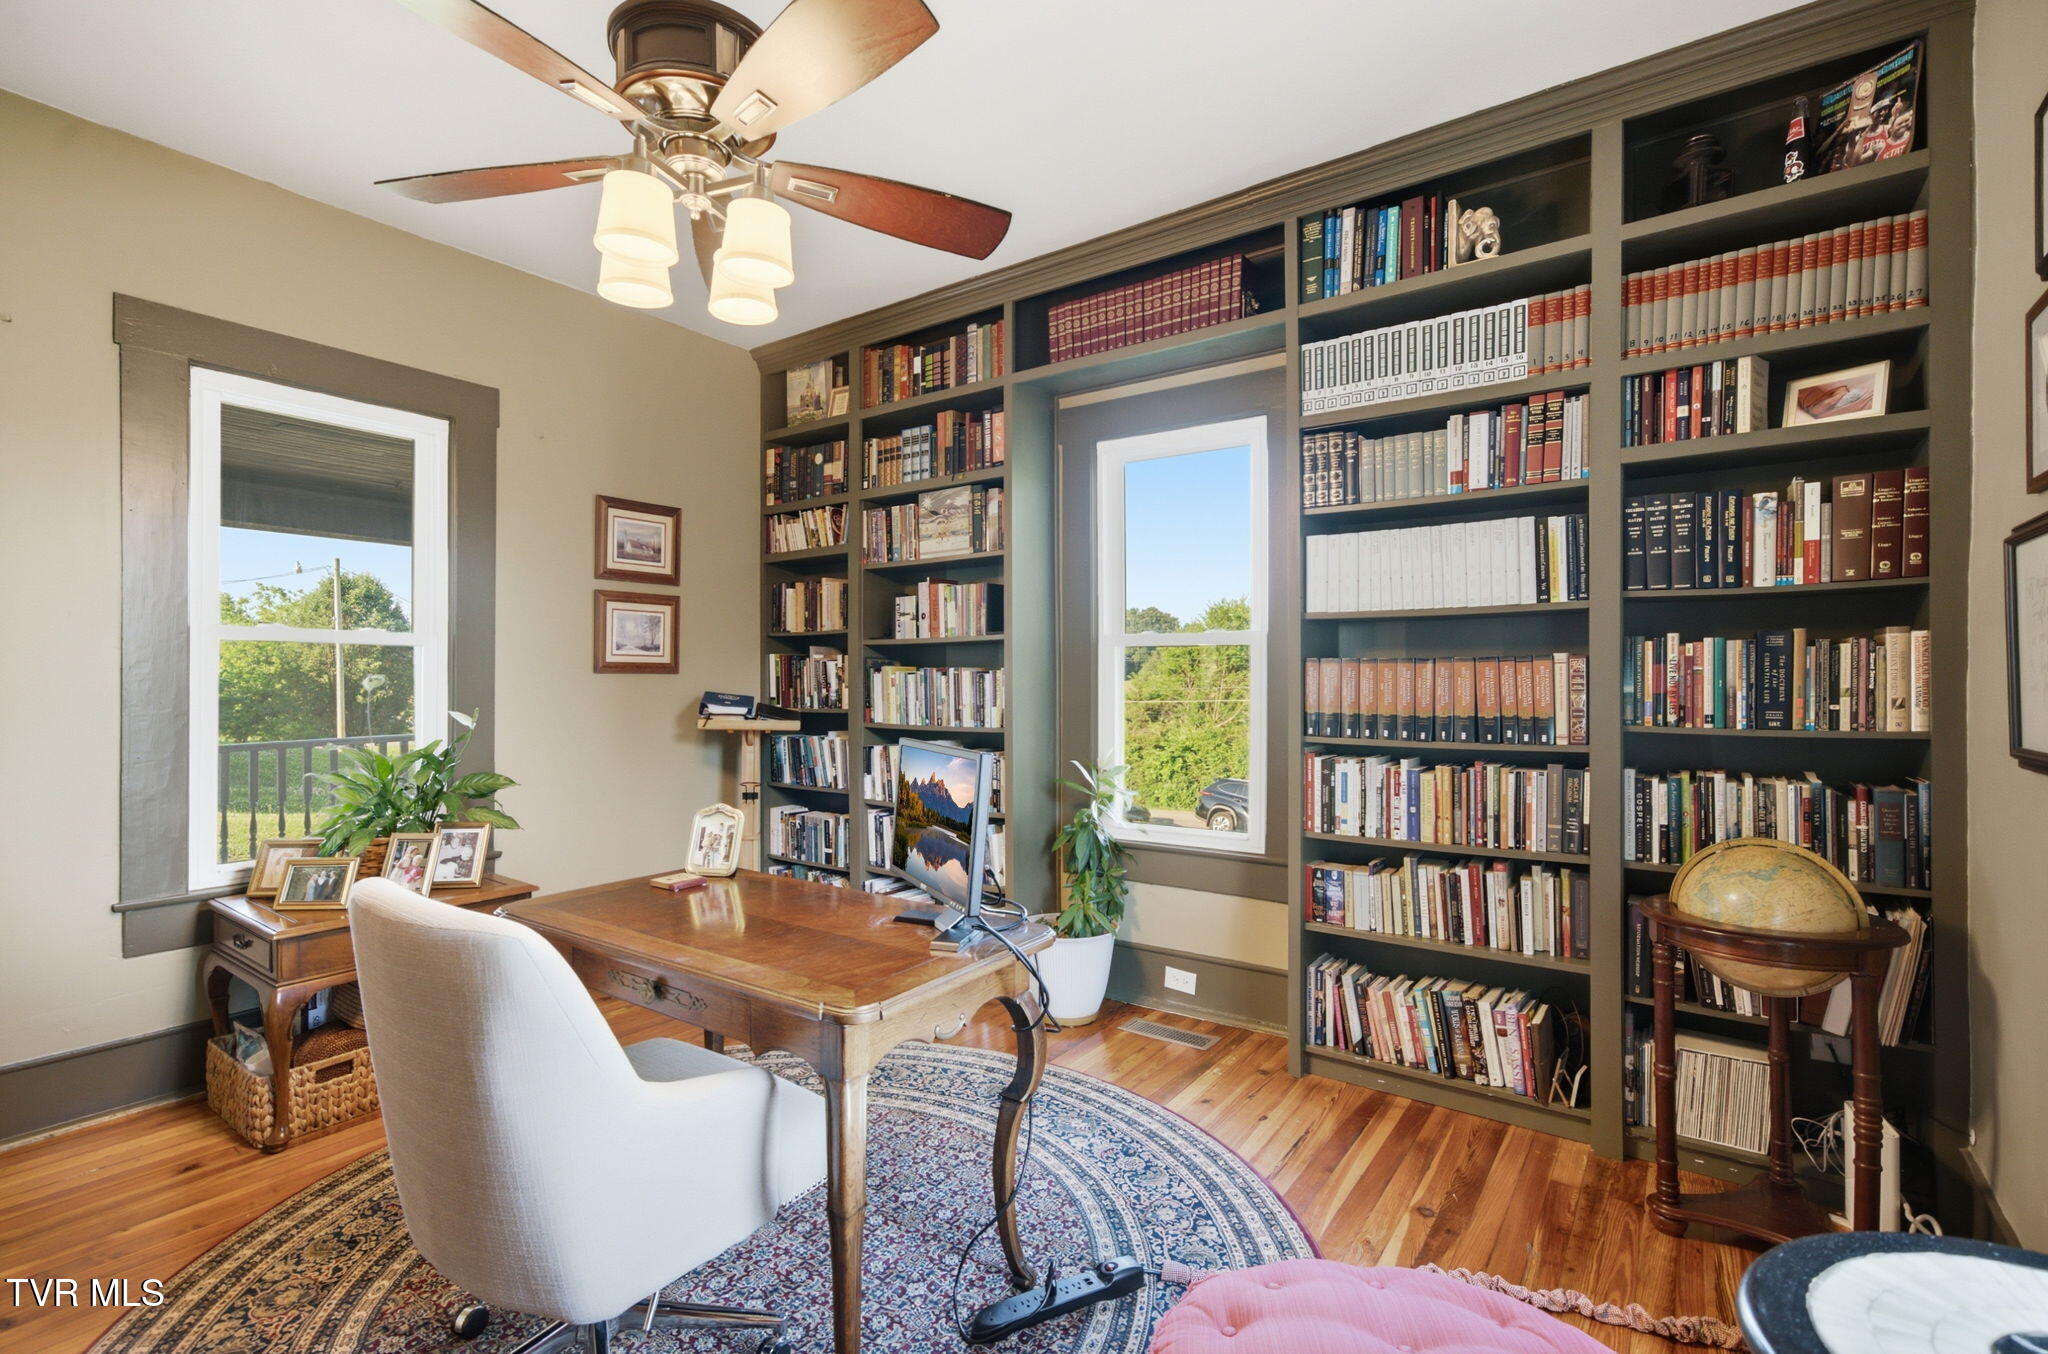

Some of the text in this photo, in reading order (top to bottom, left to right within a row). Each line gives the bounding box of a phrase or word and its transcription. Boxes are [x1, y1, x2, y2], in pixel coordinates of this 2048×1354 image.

[1889, 293, 1903, 301] 26
[1908, 289, 1923, 297] 27
[1668, 659, 1678, 674] LIVE
